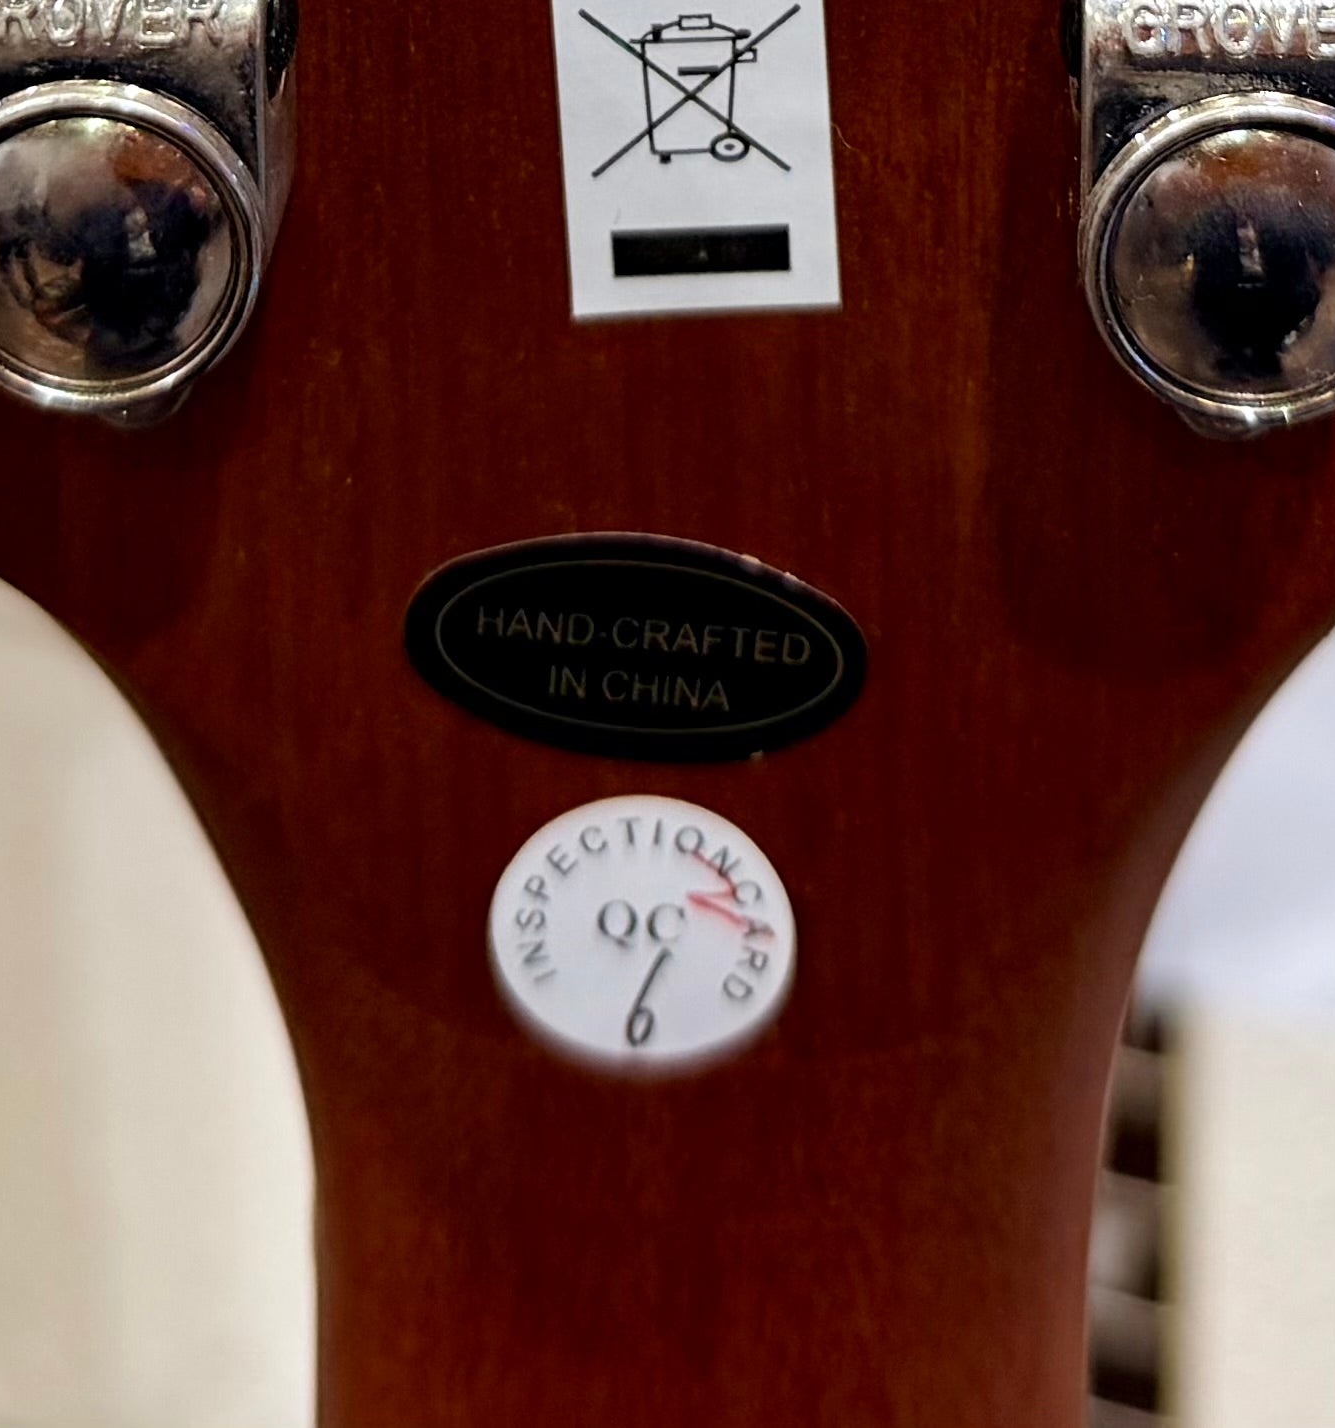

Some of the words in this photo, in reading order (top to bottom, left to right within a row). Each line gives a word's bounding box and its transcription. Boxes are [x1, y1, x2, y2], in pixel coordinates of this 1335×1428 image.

[476, 605, 811, 666] HAND-CRAFTED
[547, 664, 587, 700] IN
[601, 669, 731, 712] CHINA
[515, 816, 744, 986] INSPECTION
[722, 877, 773, 1004] CARD
[597, 899, 687, 950] QC
